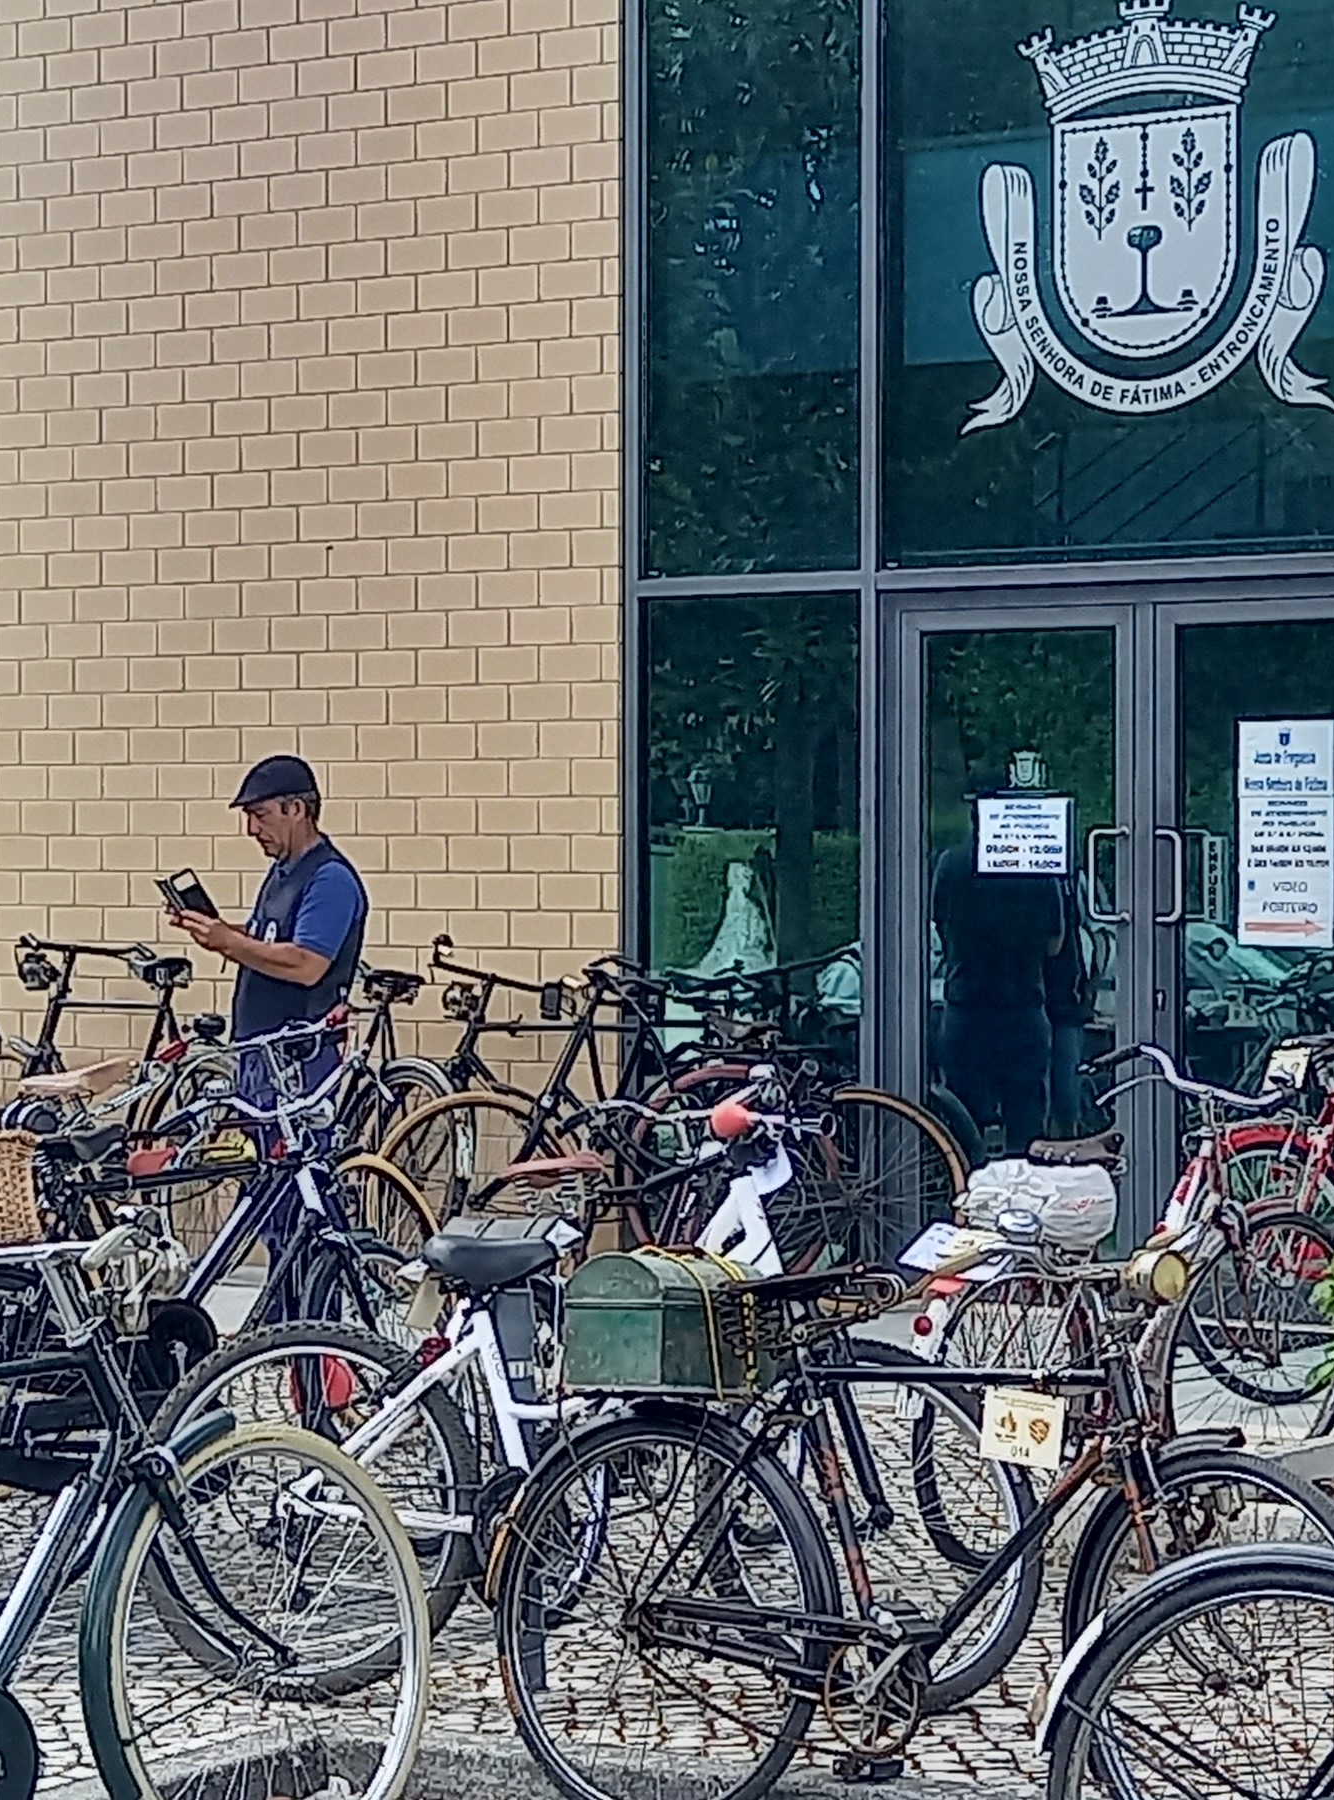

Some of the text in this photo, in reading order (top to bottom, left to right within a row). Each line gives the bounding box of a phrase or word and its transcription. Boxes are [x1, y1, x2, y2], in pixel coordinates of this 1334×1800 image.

[1013, 241, 1031, 311] NOSSA
[1025, 315, 1085, 396] SENHORA
[1090, 383, 1114, 401] DE
[1119, 381, 1186, 405] FÁTIMA
[1199, 218, 1280, 383] ENTRONCAMENTO
